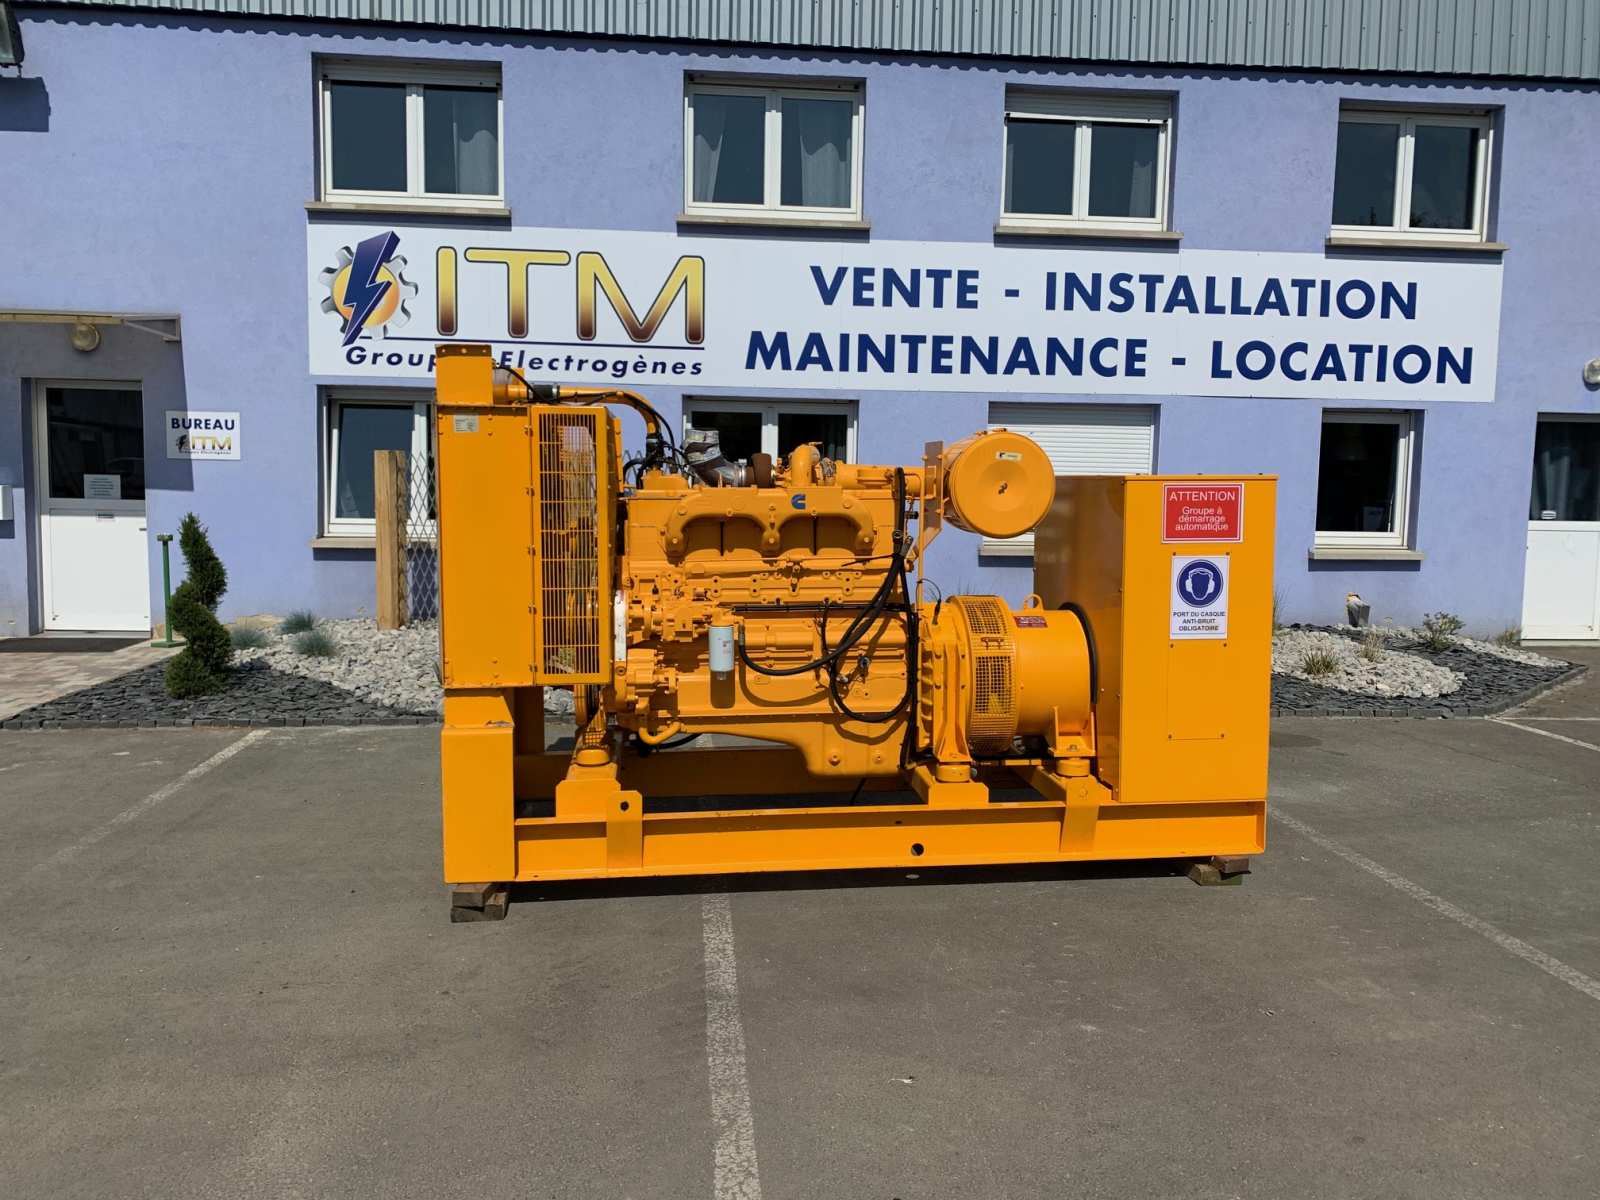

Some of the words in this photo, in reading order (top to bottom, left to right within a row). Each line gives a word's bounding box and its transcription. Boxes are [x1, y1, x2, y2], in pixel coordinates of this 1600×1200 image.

[436, 245, 705, 345] ITM
[810, 266, 979, 309] VENTE
[1005, 289, 1019, 297] -
[1046, 272, 1417, 319] INSTALLATION
[501, 350, 702, 379] Electrogènes
[745, 331, 1147, 377] MAINTENANCE
[1211, 341, 1472, 384] LOCATION
[171, 417, 235, 430] BUREAU
[191, 435, 232, 450] ITM
[1169, 491, 1236, 501] ATTENTION
[1182, 506, 1215, 516] Groupe
[1216, 506, 1223, 515] à
[1178, 515, 1226, 525] démarrage
[1175, 523, 1229, 532] automatique
